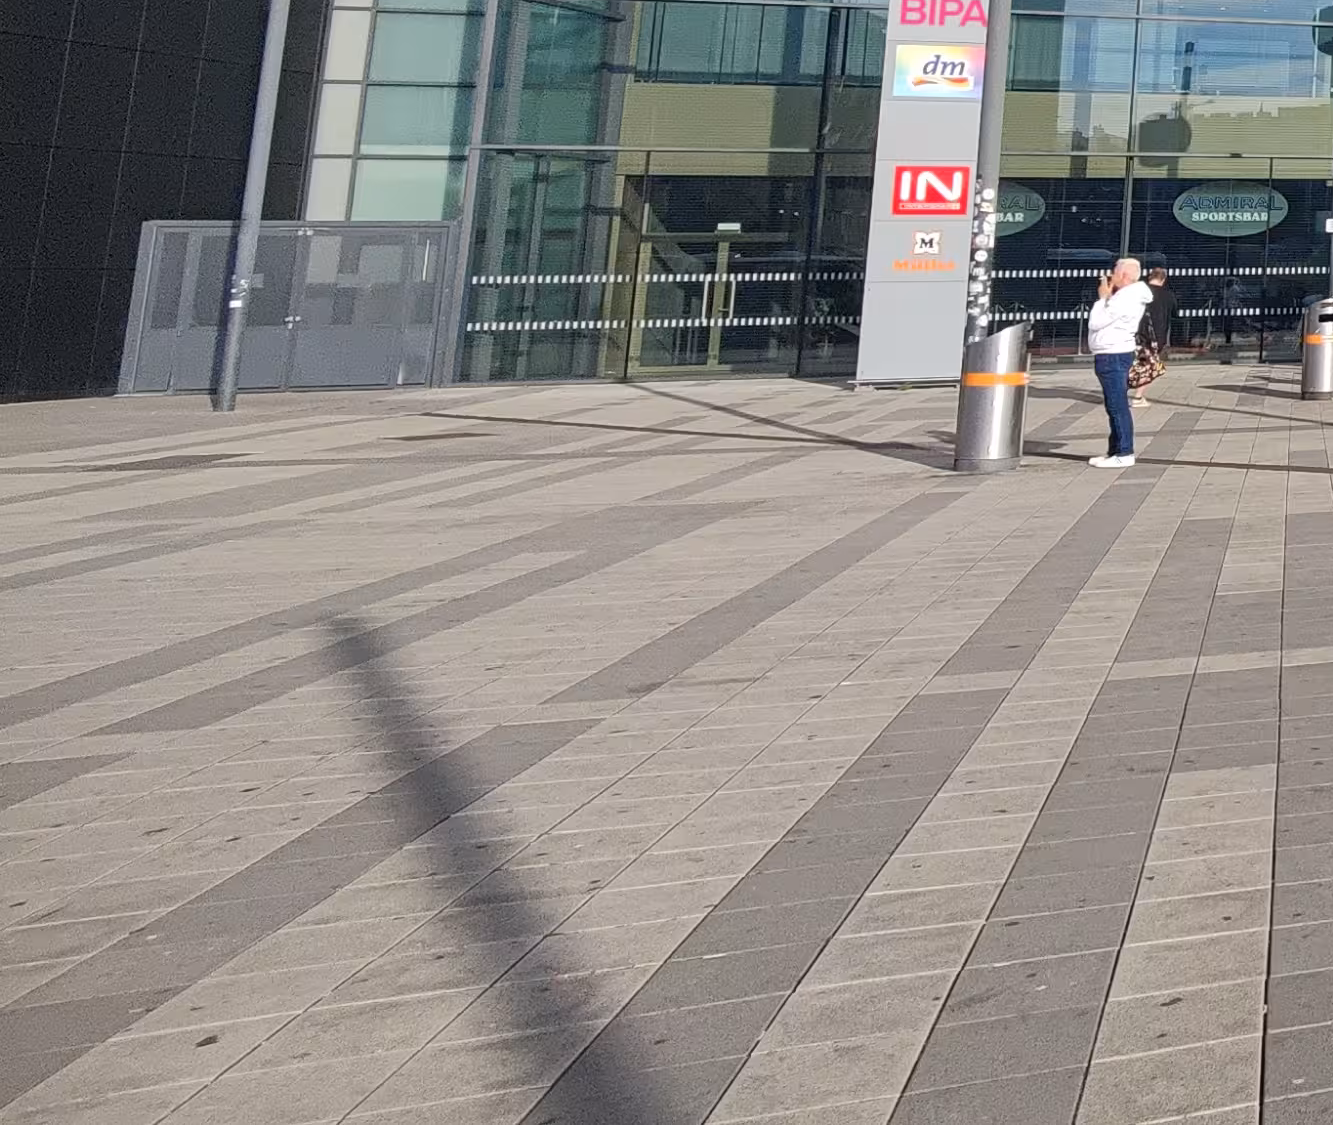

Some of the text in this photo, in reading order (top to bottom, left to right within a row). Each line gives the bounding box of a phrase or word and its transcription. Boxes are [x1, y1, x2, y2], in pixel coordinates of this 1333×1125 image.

[922, 54, 965, 76] dm
[899, 170, 963, 201] IN
[1178, 195, 1283, 211] ADMIRAL
[1191, 211, 1269, 222] SPORTSBAR
[919, 238, 934, 249] M
